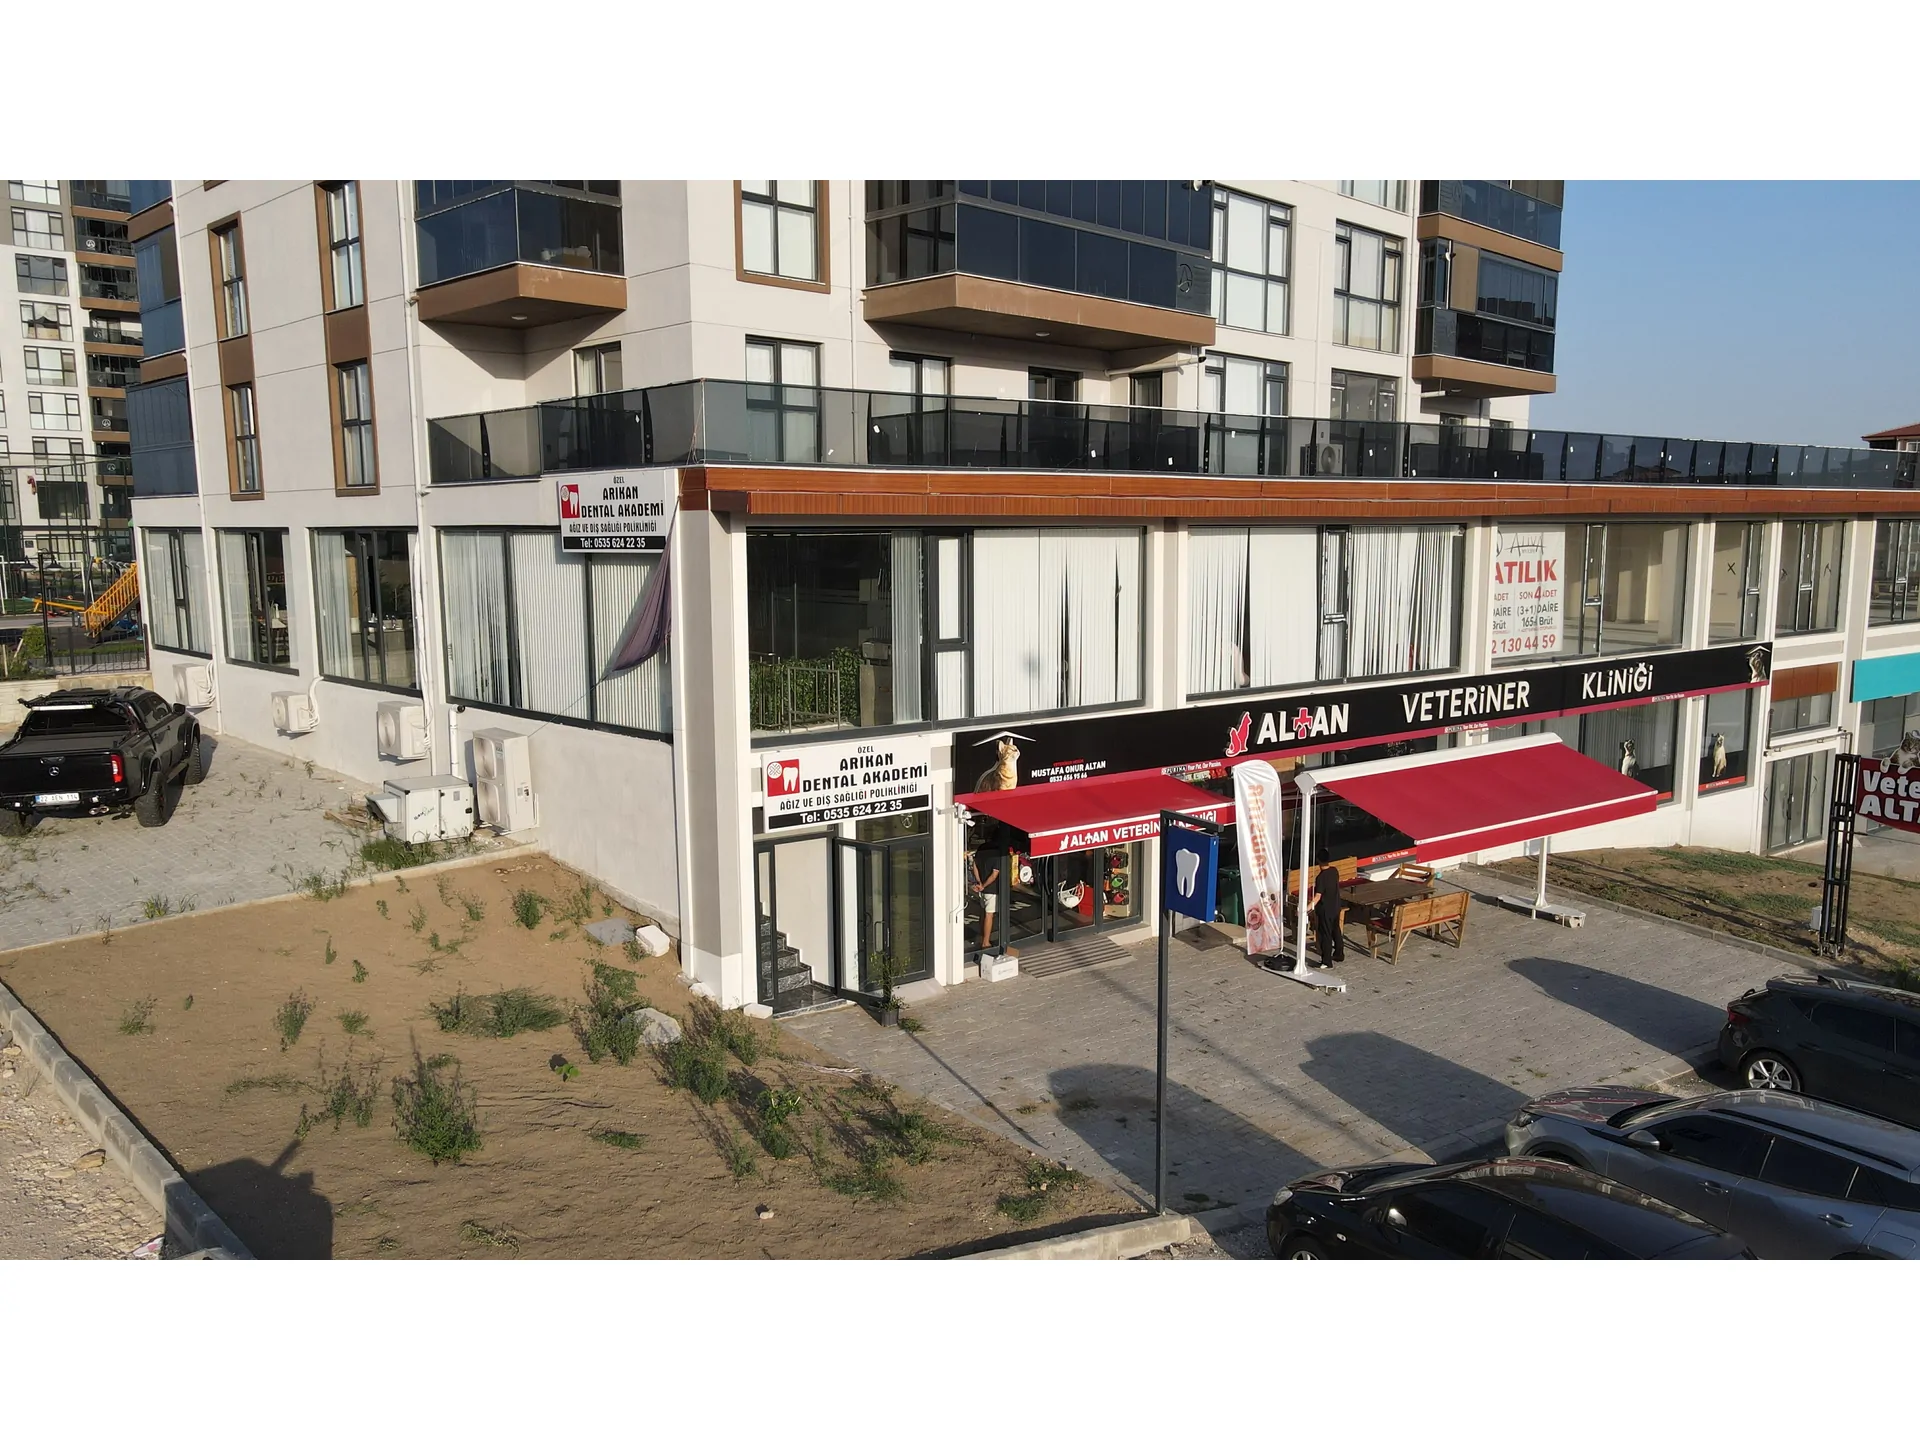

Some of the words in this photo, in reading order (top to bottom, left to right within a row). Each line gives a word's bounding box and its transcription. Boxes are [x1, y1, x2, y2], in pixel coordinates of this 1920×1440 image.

[613, 476, 625, 484] ÖZEL
[603, 486, 638, 500] ARIKAN
[581, 504, 615, 518] DENTAL
[618, 500, 664, 517] AKADEMİ
[569, 521, 581, 533] AĞIZ
[582, 523, 588, 533] VE
[590, 522, 599, 534] DİŞ
[580, 538, 593, 548] Tel:
[594, 538, 611, 548] 0535
[612, 538, 625, 548] 624
[626, 538, 636, 548] 22
[637, 538, 646, 548] 35
[1519, 591, 1533, 600] SON
[1534, 586, 1541, 599] 4
[1501, 637, 1522, 653] 130
[1524, 635, 1539, 650] 44
[1542, 633, 1556, 649] 59
[857, 746, 874, 754] ÖZEL
[839, 753, 893, 771] ARIKAN
[1031, 766, 1064, 778] MUSTAFA
[1065, 763, 1084, 773] ONUR
[1085, 760, 1106, 771] ALTAN
[803, 775, 857, 793] DENTAL
[862, 762, 928, 785] AKADEMİ
[780, 798, 800, 811] AĞIZ
[803, 797, 813, 808] VE
[816, 795, 831, 807] DİŞ
[834, 789, 867, 803] SAĞLIĞI
[1859, 795, 1920, 823] ALT
[800, 811, 820, 824] Tel:
[823, 807, 850, 820] 0535
[852, 804, 872, 817] 624
[874, 801, 887, 813] 22
[889, 799, 902, 811] 35
